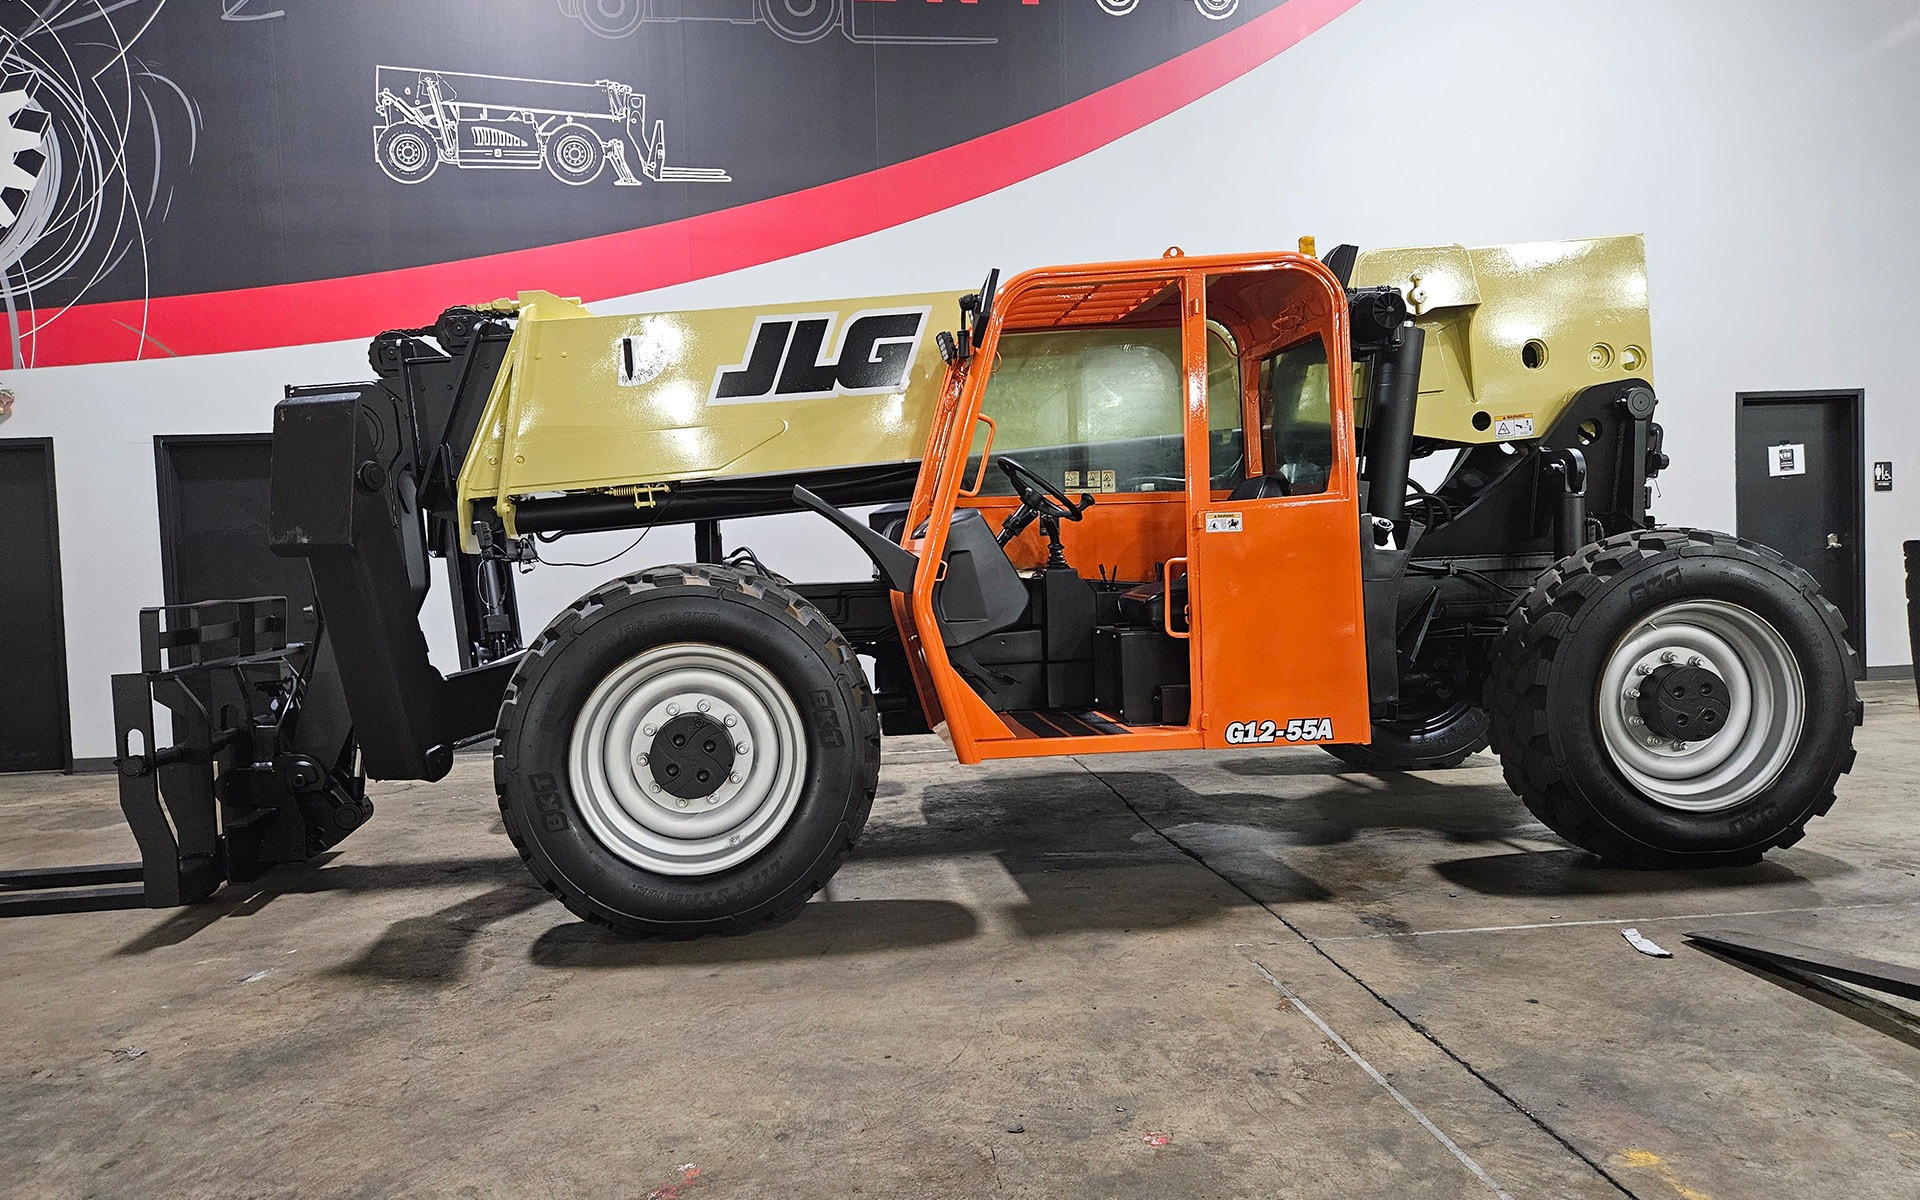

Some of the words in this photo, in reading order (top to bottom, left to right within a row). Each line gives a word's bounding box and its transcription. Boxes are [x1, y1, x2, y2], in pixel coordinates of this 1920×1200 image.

[712, 309, 926, 401] JLG
[810, 690, 846, 749] BKT
[1225, 718, 1334, 744] G12-55A
[529, 771, 570, 832] BKT
